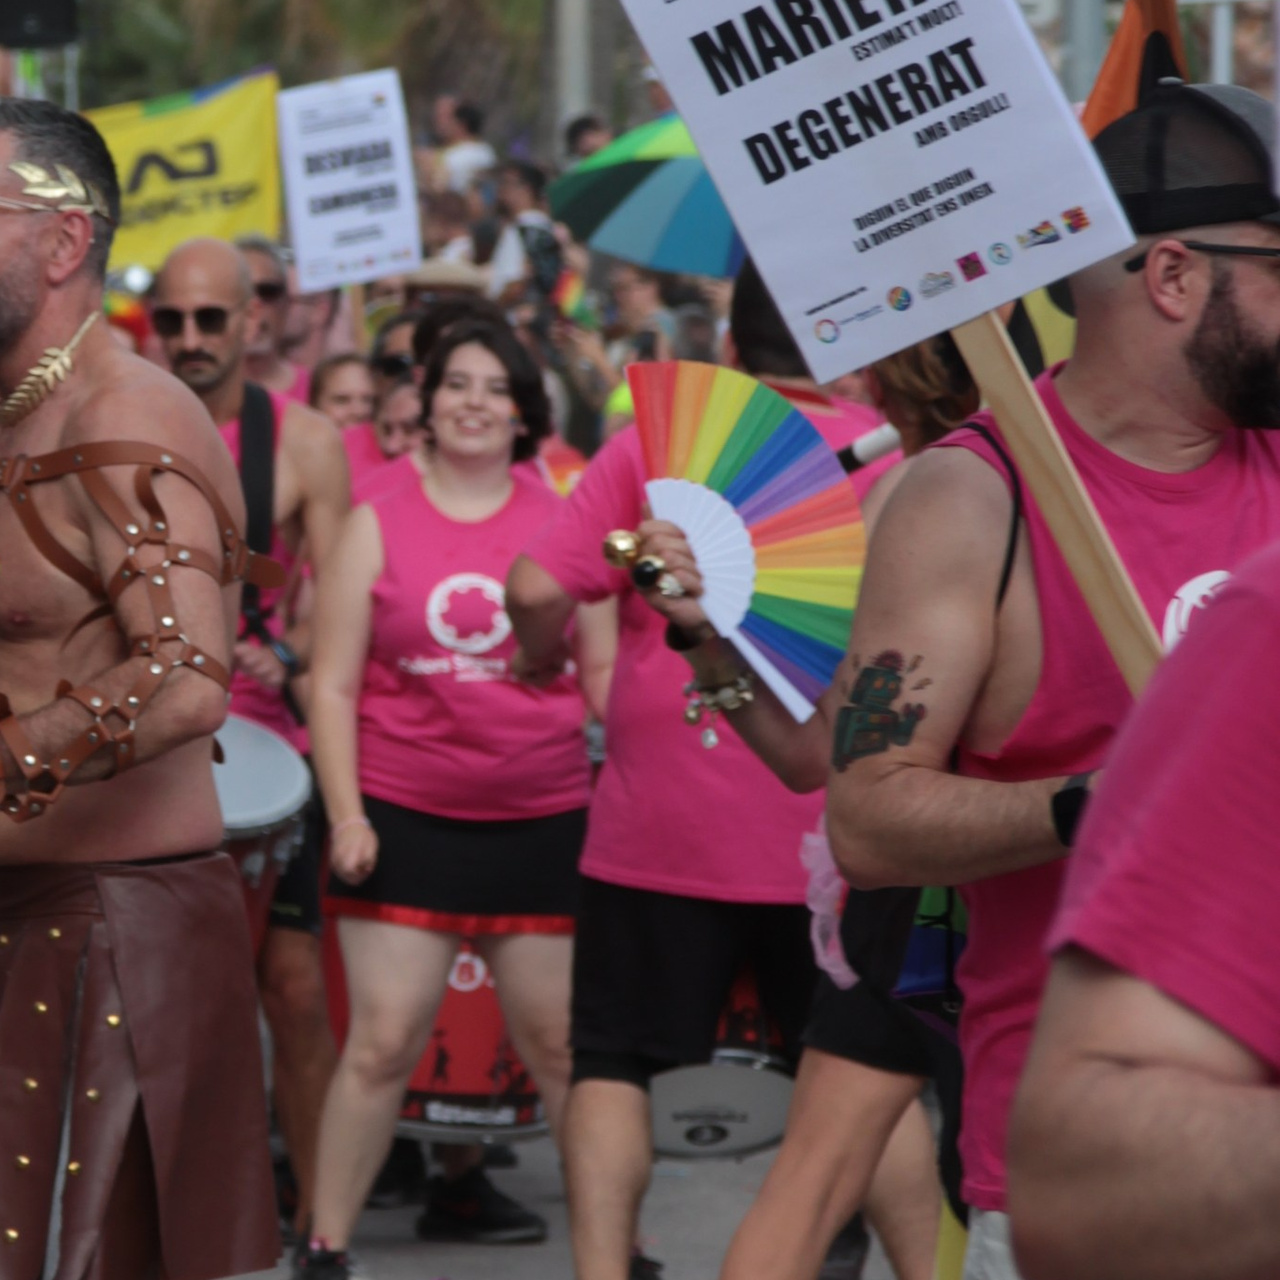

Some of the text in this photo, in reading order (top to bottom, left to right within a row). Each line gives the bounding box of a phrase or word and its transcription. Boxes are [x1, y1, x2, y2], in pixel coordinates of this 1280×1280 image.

[850, 0, 962, 61] ESTIMA'T MOLT!
[742, 36, 987, 185] DEGENERAT
[913, 92, 1010, 148] AMB ORGULL!
[853, 167, 975, 230] DIGUIN EL QUE DIGUIN
[853, 237, 872, 253] LA
[868, 207, 934, 246] DIVERSITAT
